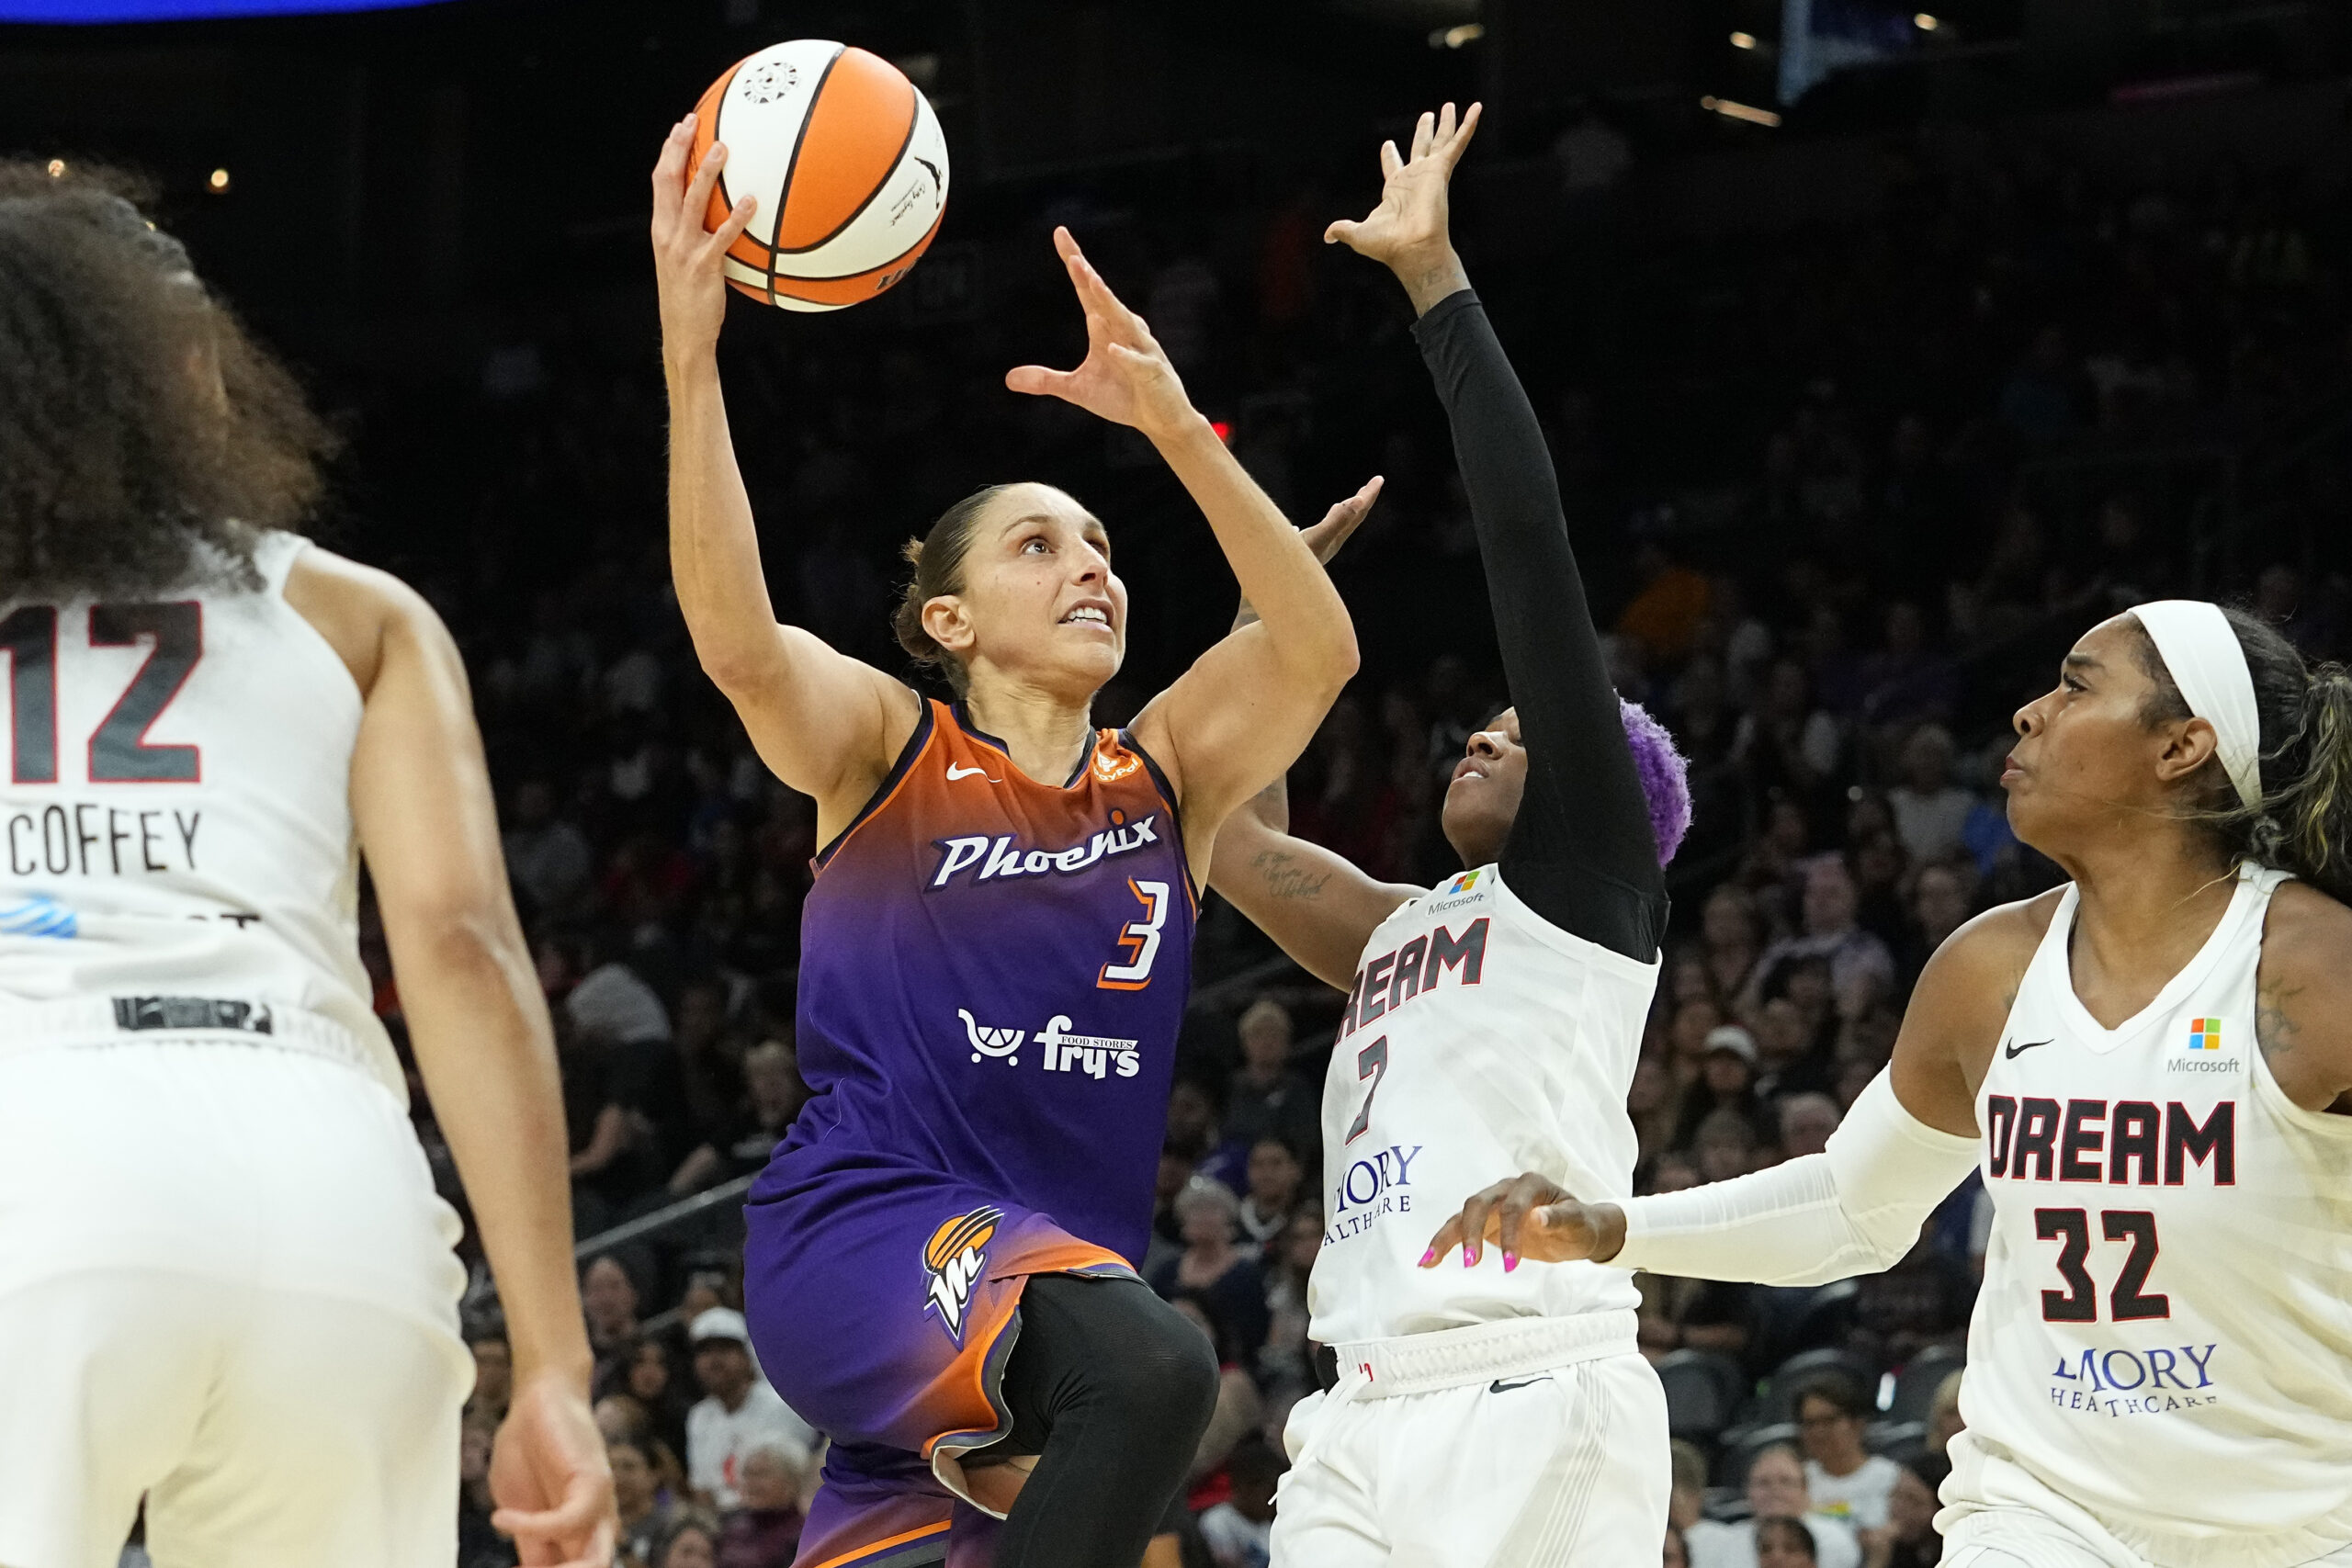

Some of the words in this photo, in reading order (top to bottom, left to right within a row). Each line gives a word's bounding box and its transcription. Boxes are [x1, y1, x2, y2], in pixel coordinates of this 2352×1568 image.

[0, 600, 204, 784] 12
[8, 804, 201, 876] COFFEY
[926, 808, 1161, 888] Phoenix
[1096, 876, 1170, 991] 3
[1428, 893, 1485, 917] Microsoft
[1334, 918, 1490, 1046] REAM
[1033, 1014, 1140, 1080] fry's
[1060, 1035, 1090, 1046] FOOD
[1092, 1038, 1134, 1050] STORES
[2166, 1056, 2240, 1074] Microsoft
[1345, 1034, 1388, 1146] 7
[1988, 1094, 2236, 1187] DREAM
[2033, 1207, 2171, 1323] 32
